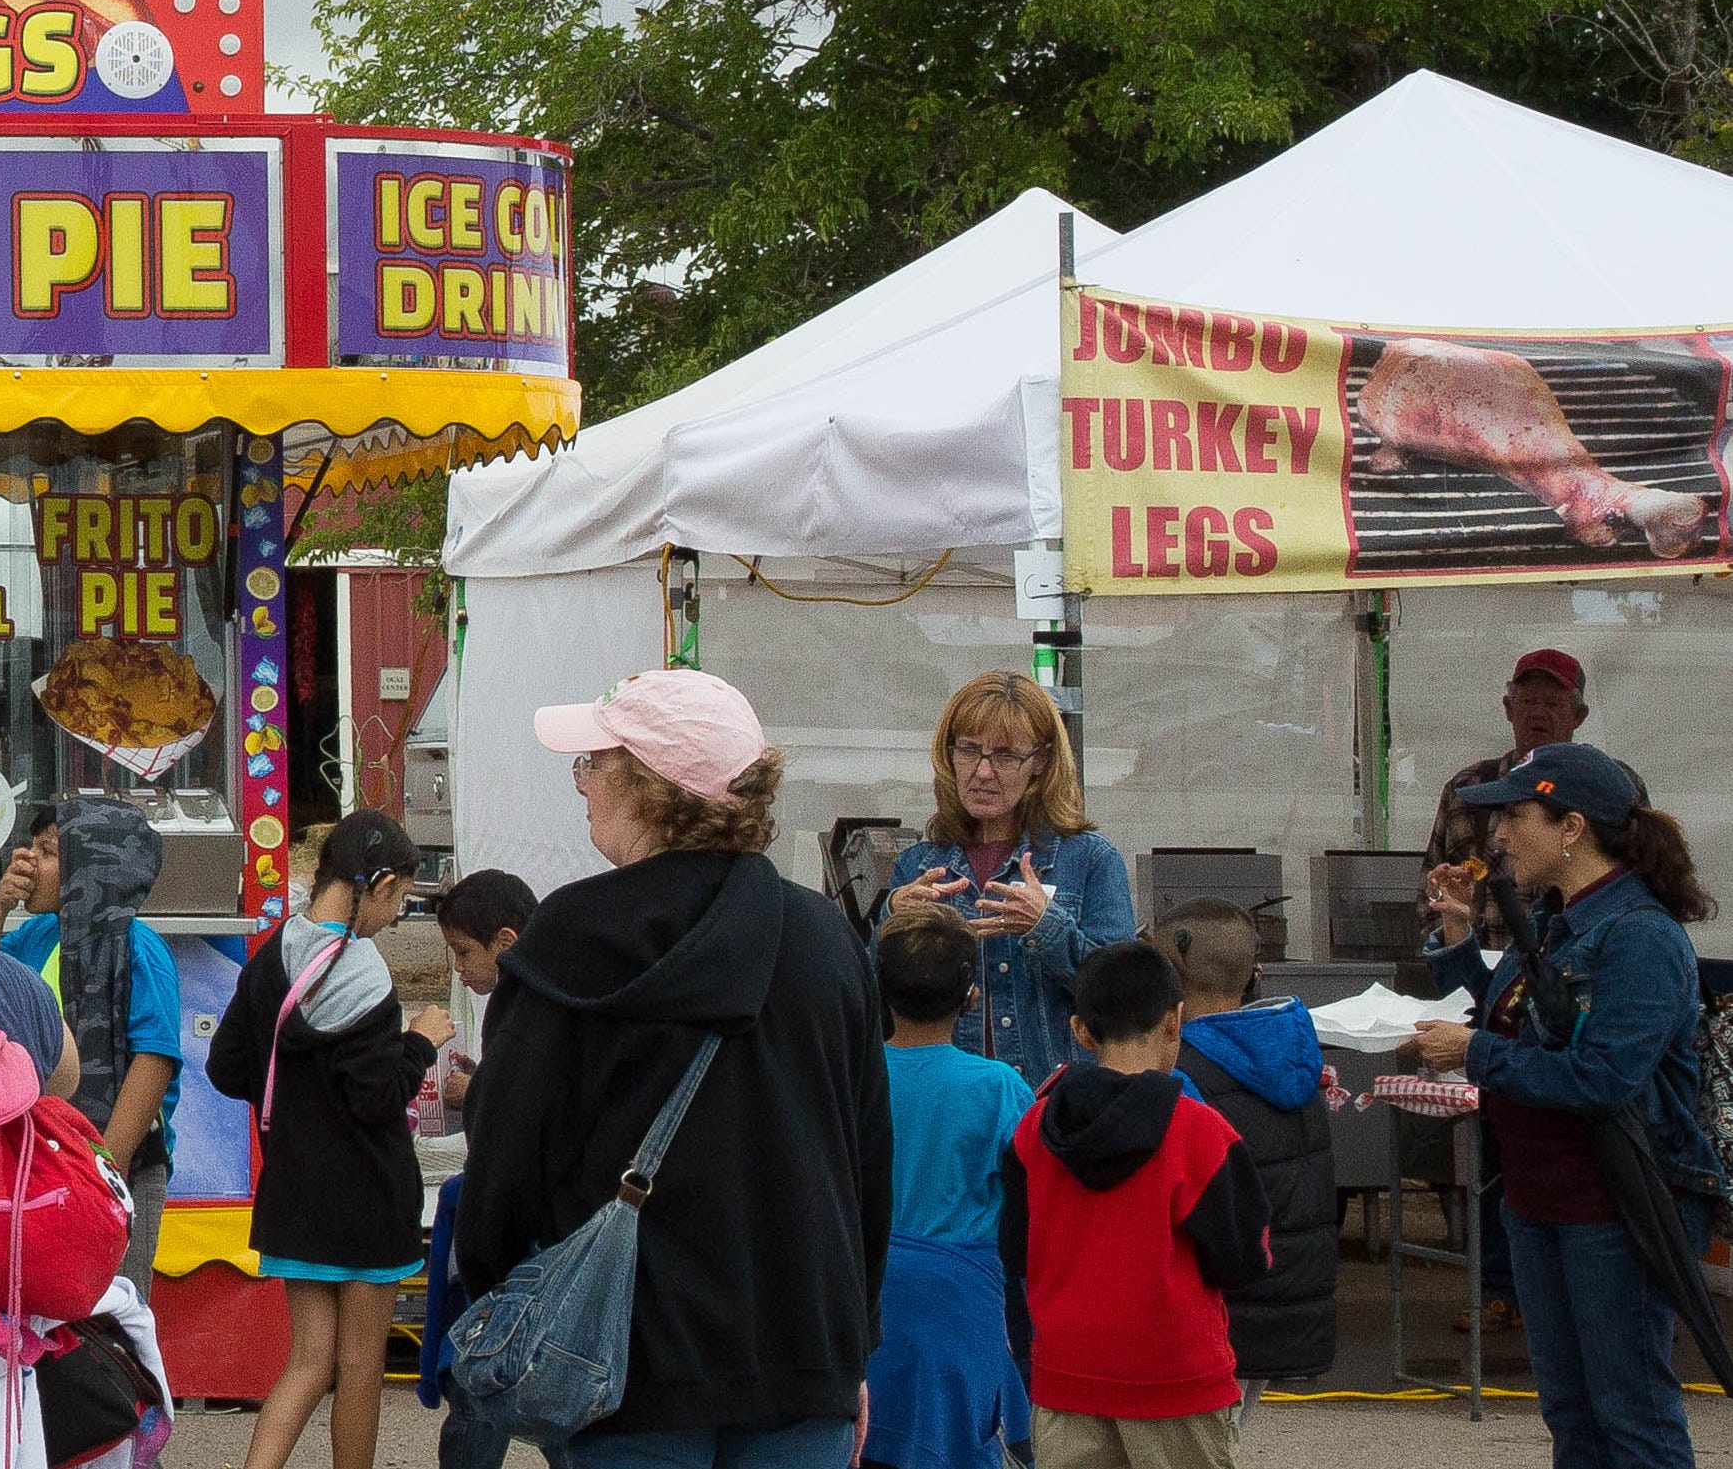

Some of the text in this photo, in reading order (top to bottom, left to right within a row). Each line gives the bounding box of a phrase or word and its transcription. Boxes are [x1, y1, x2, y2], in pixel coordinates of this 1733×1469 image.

[377, 174, 483, 254] ICE
[15, 193, 233, 317] PIE
[1073, 294, 1308, 374] JUMBO
[1063, 397, 1321, 475] TURKEY
[41, 495, 217, 565] FRITO
[1111, 506, 1277, 578] LEGS
[80, 570, 179, 637] PIE
